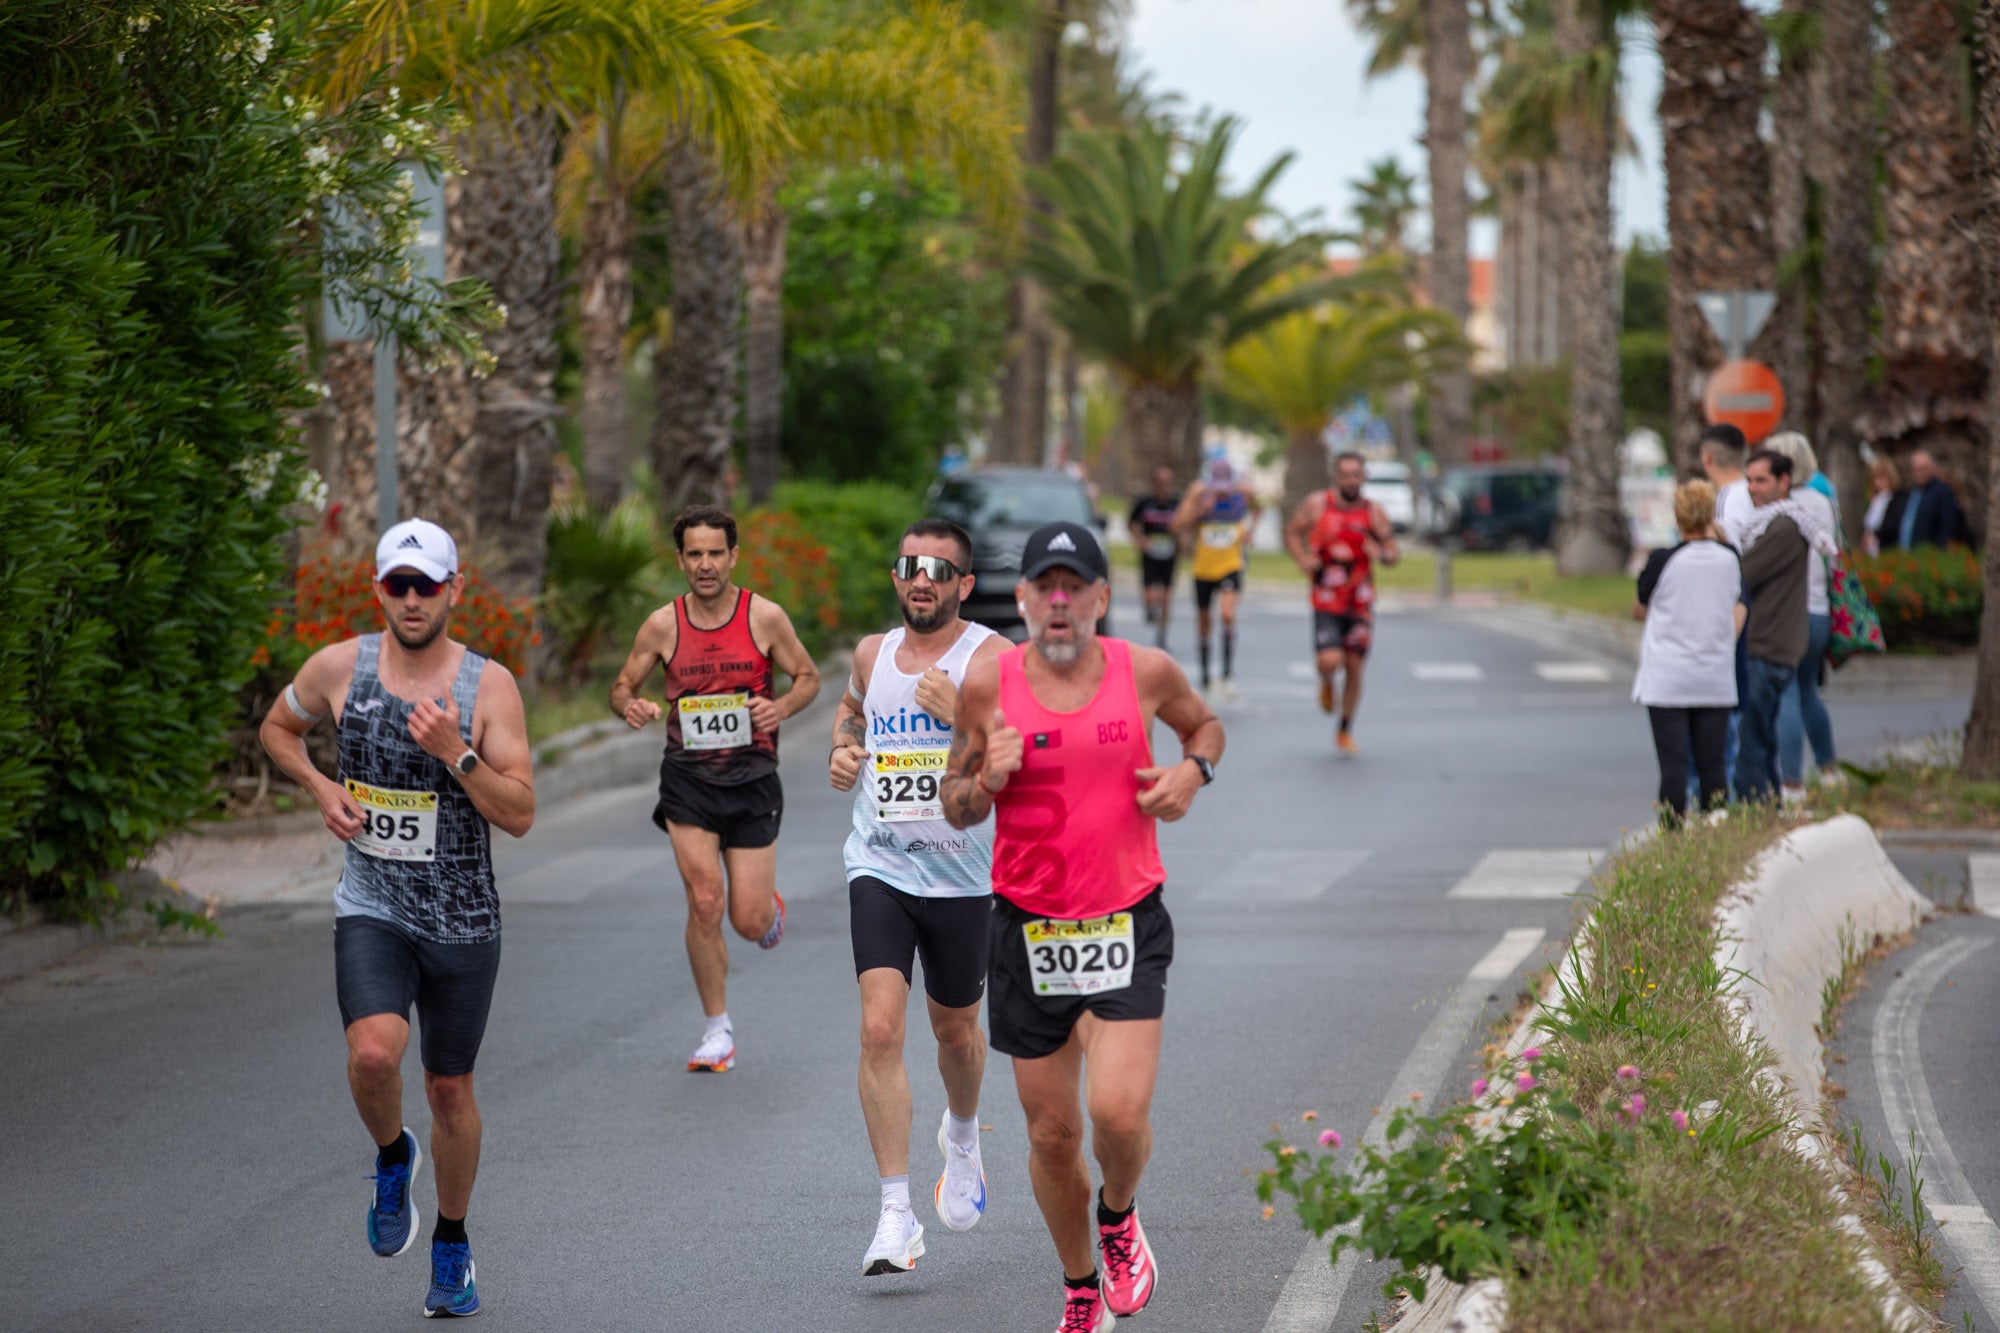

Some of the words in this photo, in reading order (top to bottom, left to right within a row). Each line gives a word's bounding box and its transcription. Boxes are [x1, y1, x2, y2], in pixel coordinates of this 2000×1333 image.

[719, 661, 754, 672] RUNNING
[692, 713, 738, 735] 140
[1097, 721, 1128, 745] BCC
[885, 754, 896, 767] 38
[896, 756, 943, 768] FONDO
[357, 785, 369, 800] 38
[877, 775, 942, 804] 329
[1033, 941, 1129, 974] 3020
